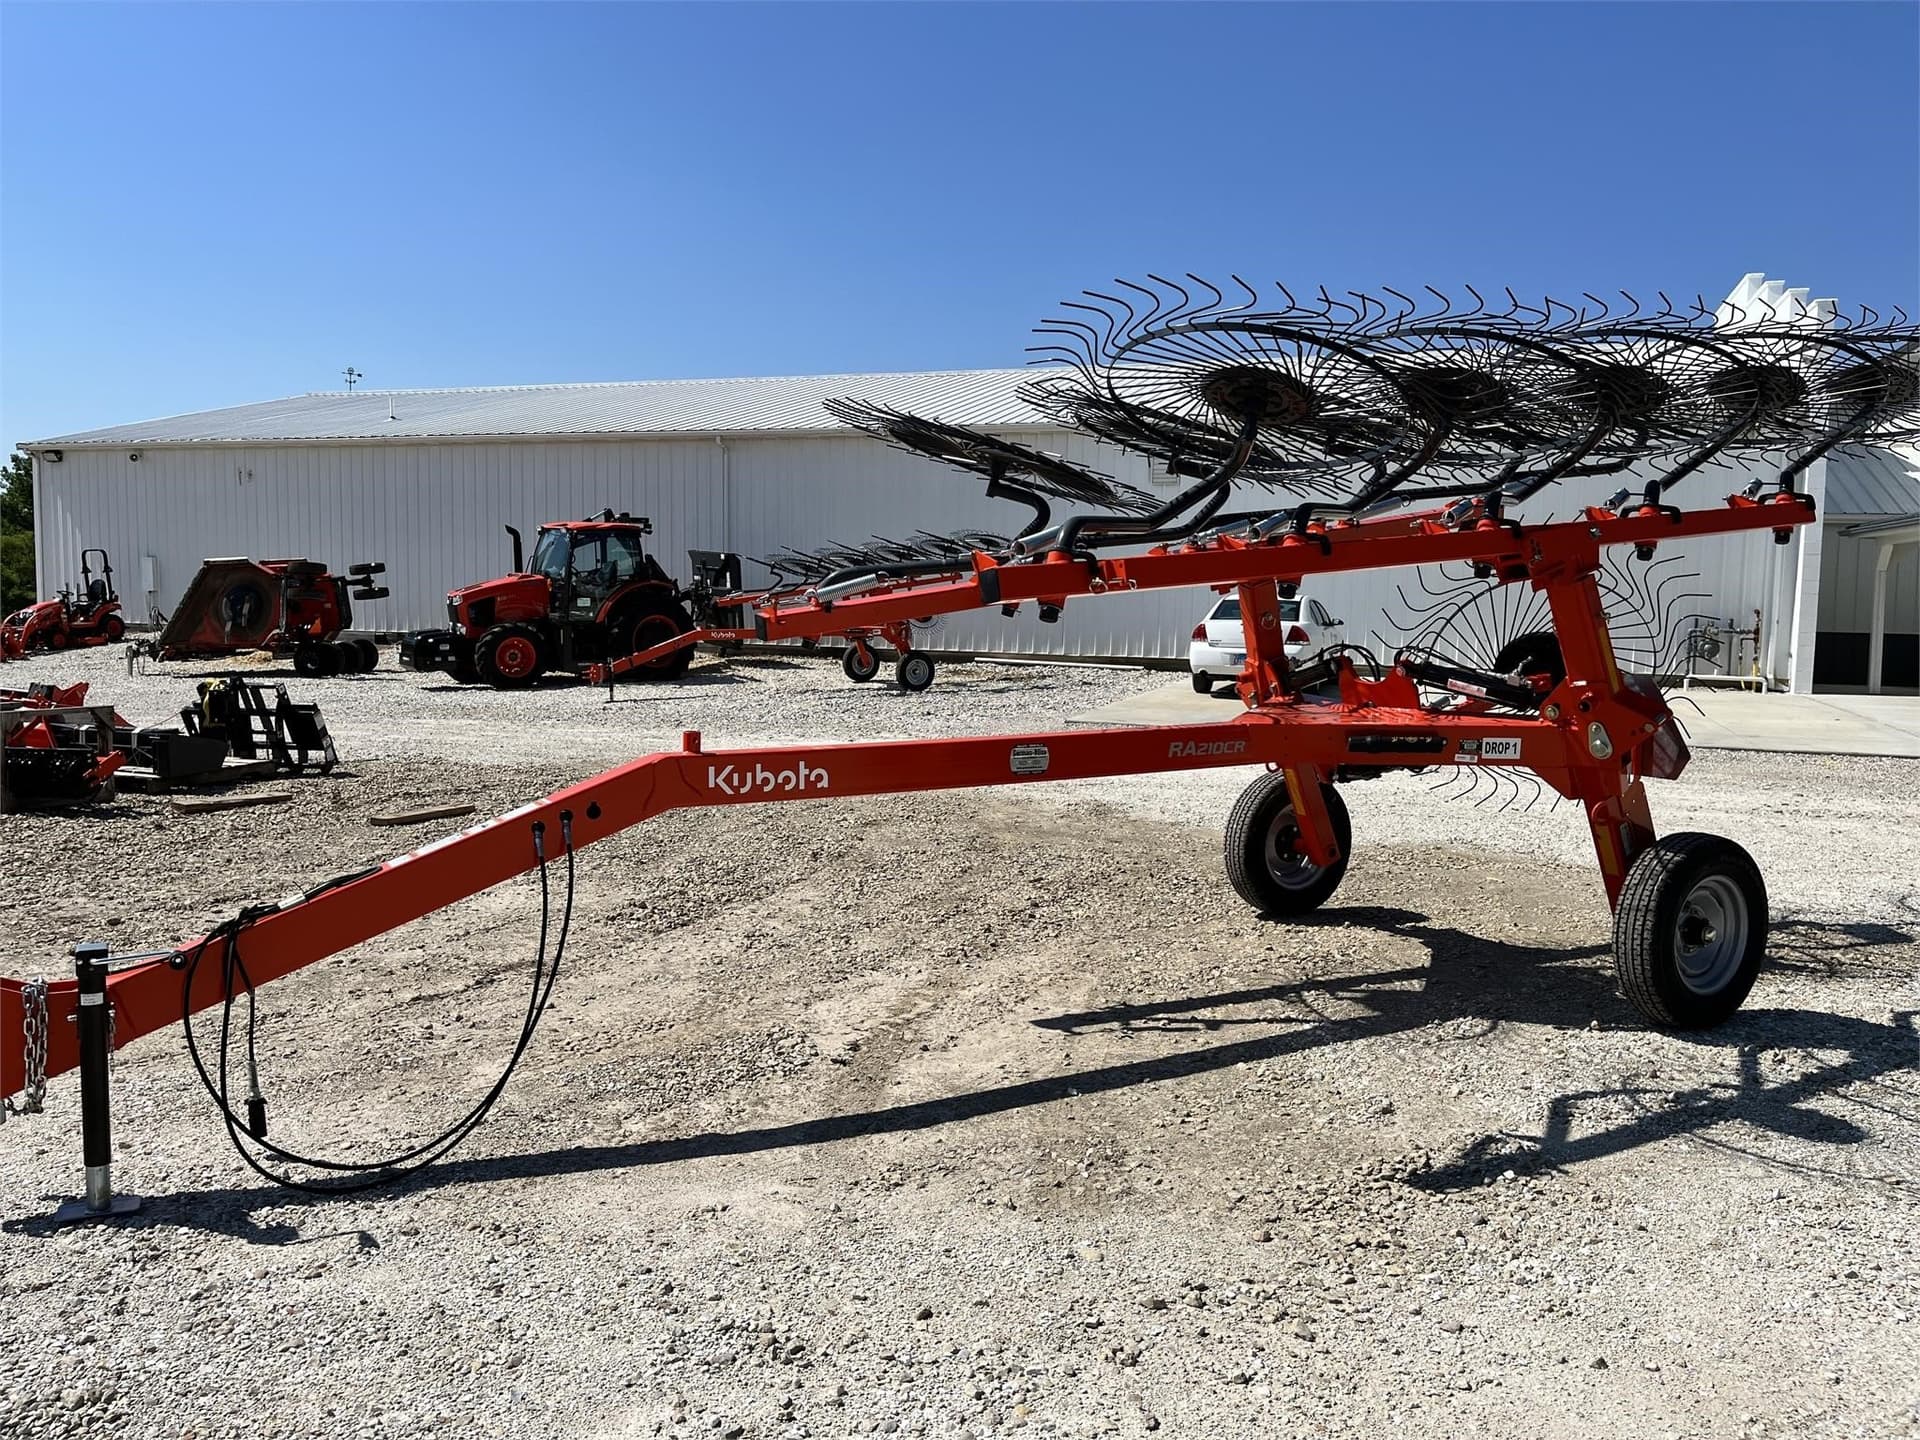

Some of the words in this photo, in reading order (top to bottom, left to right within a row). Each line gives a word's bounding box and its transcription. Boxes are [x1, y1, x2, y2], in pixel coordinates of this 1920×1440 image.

[1168, 741, 1246, 758] RA210CR
[1485, 742, 1510, 754] DROP
[1511, 742, 1517, 754] 1
[708, 760, 829, 795] Kubota
